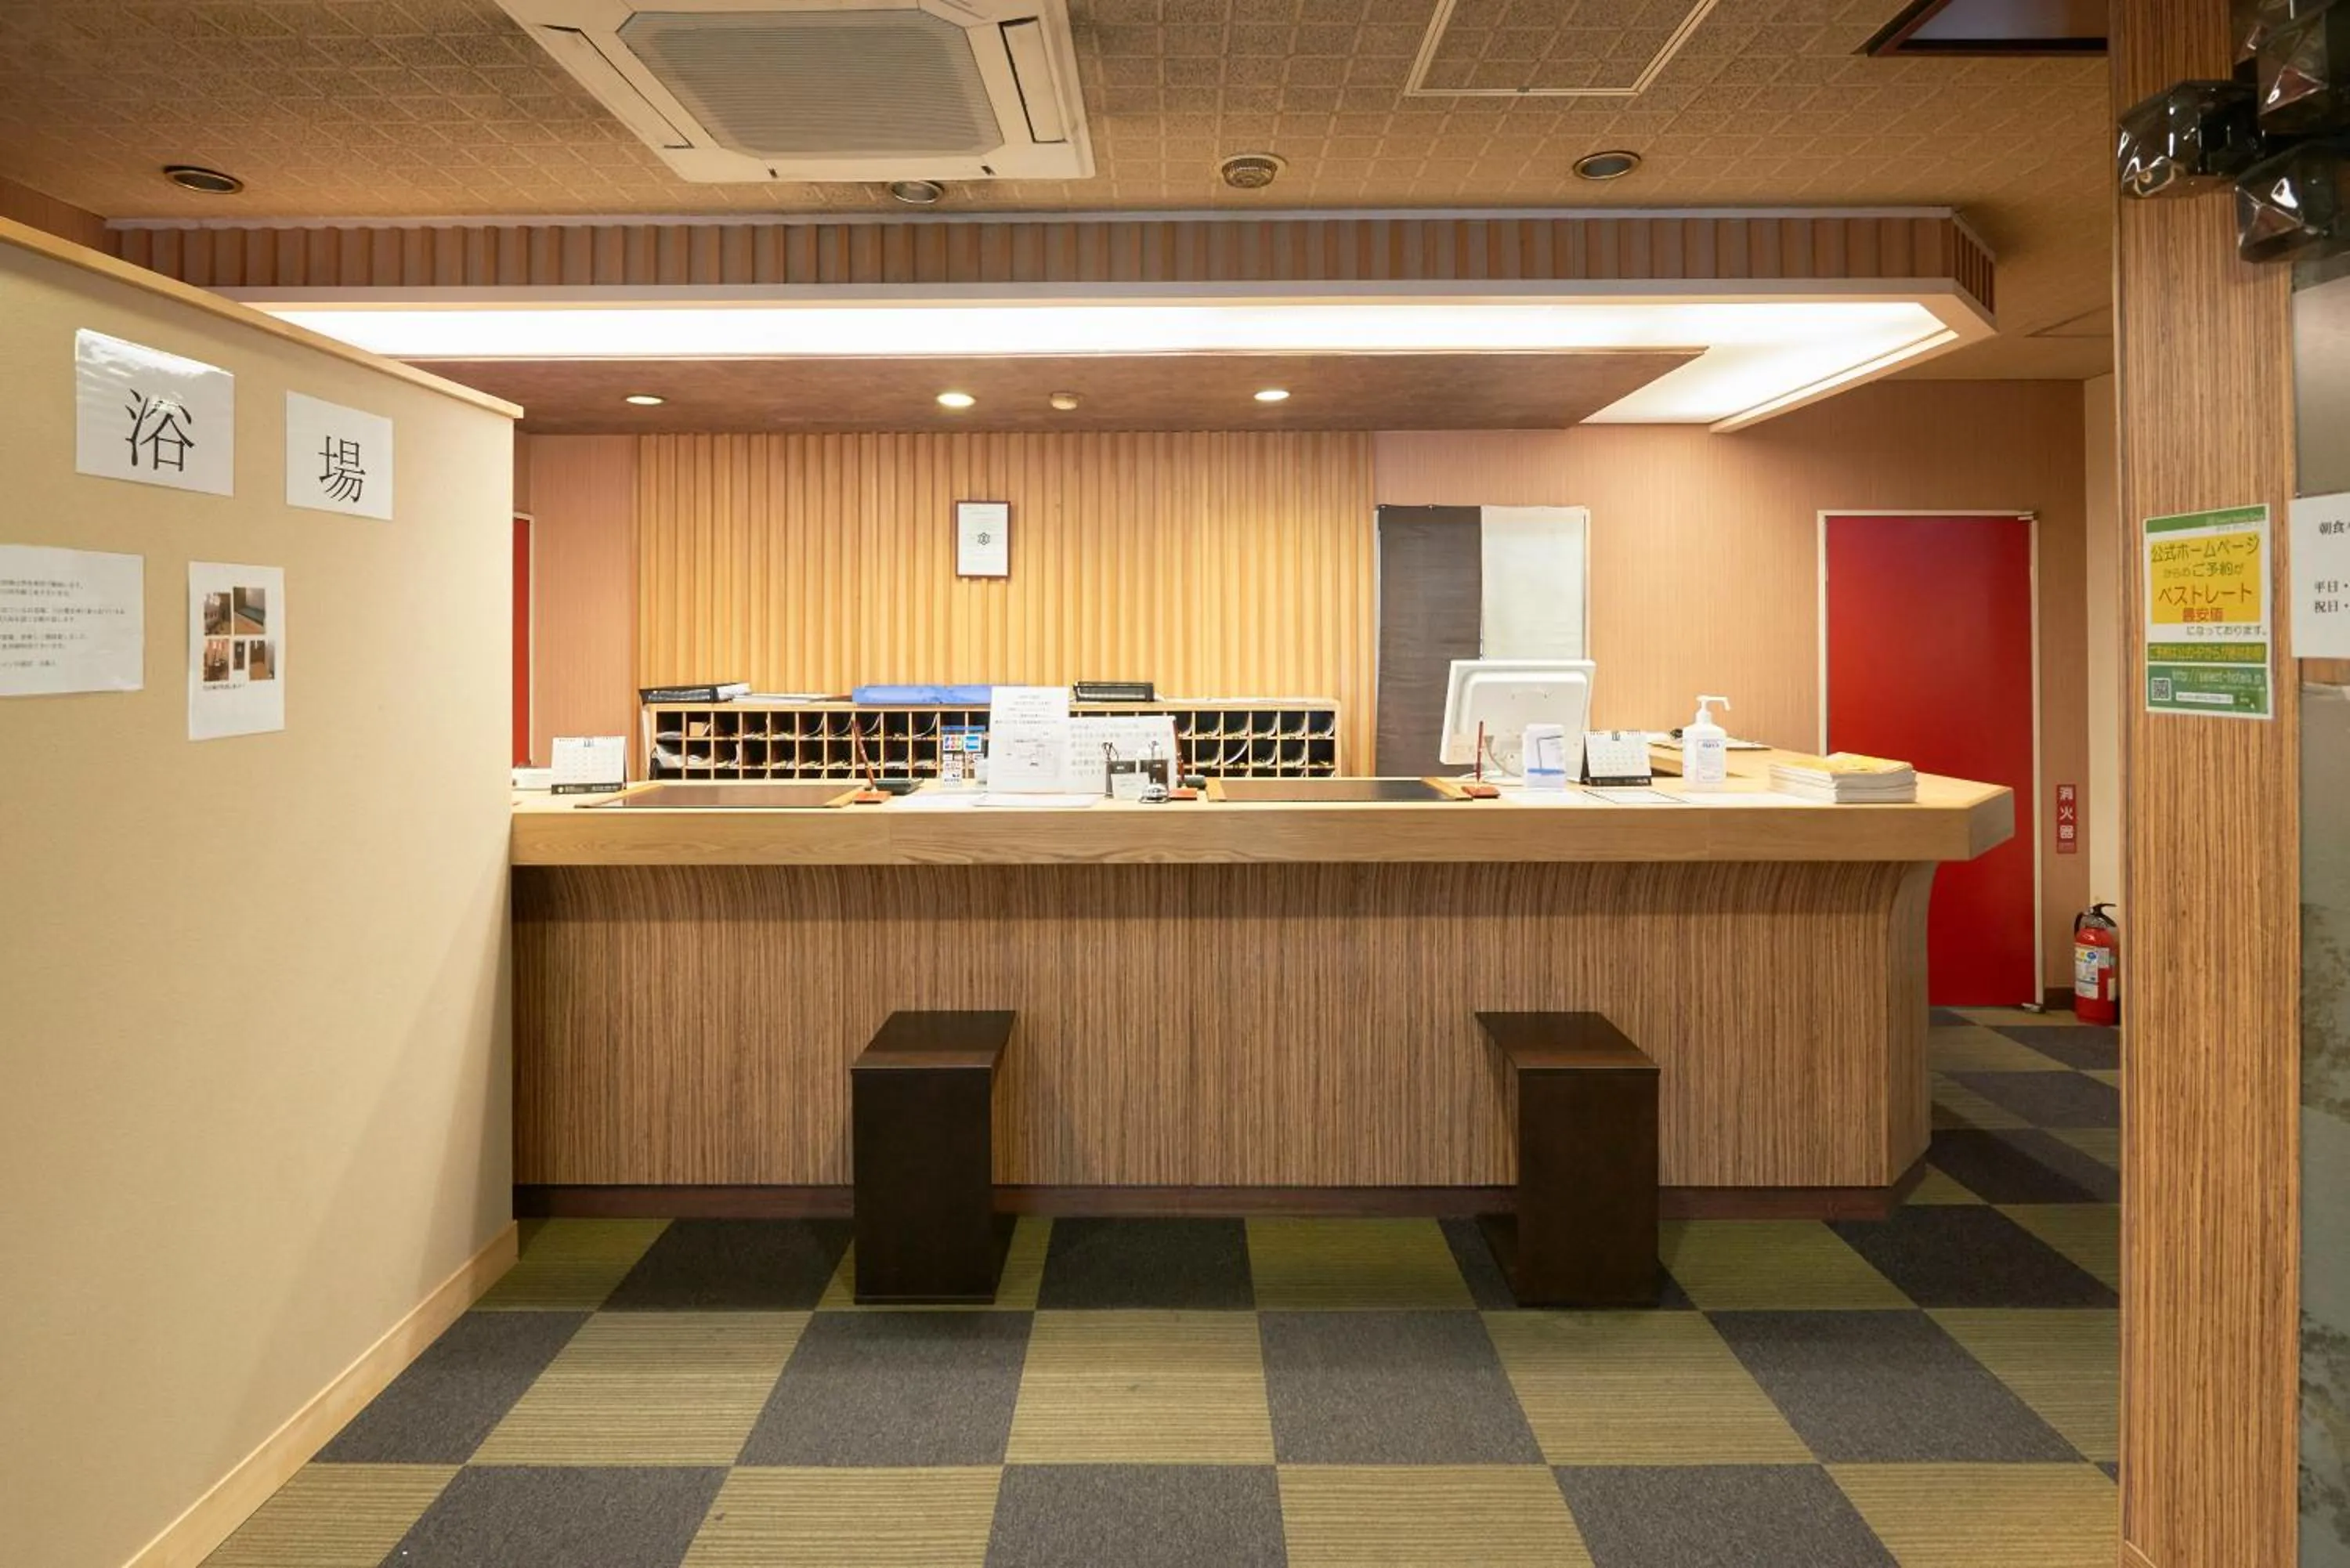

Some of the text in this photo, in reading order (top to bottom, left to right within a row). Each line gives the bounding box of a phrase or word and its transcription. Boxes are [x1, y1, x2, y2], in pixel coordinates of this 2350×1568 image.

[125, 388, 194, 471] 浴
[318, 435, 366, 503] 場
[2319, 520, 2350, 535] 朝食
[2151, 534, 2260, 562] 公式ホームページ
[2158, 582, 2252, 605] ベストレート
[2059, 786, 2074, 839] 消火器
